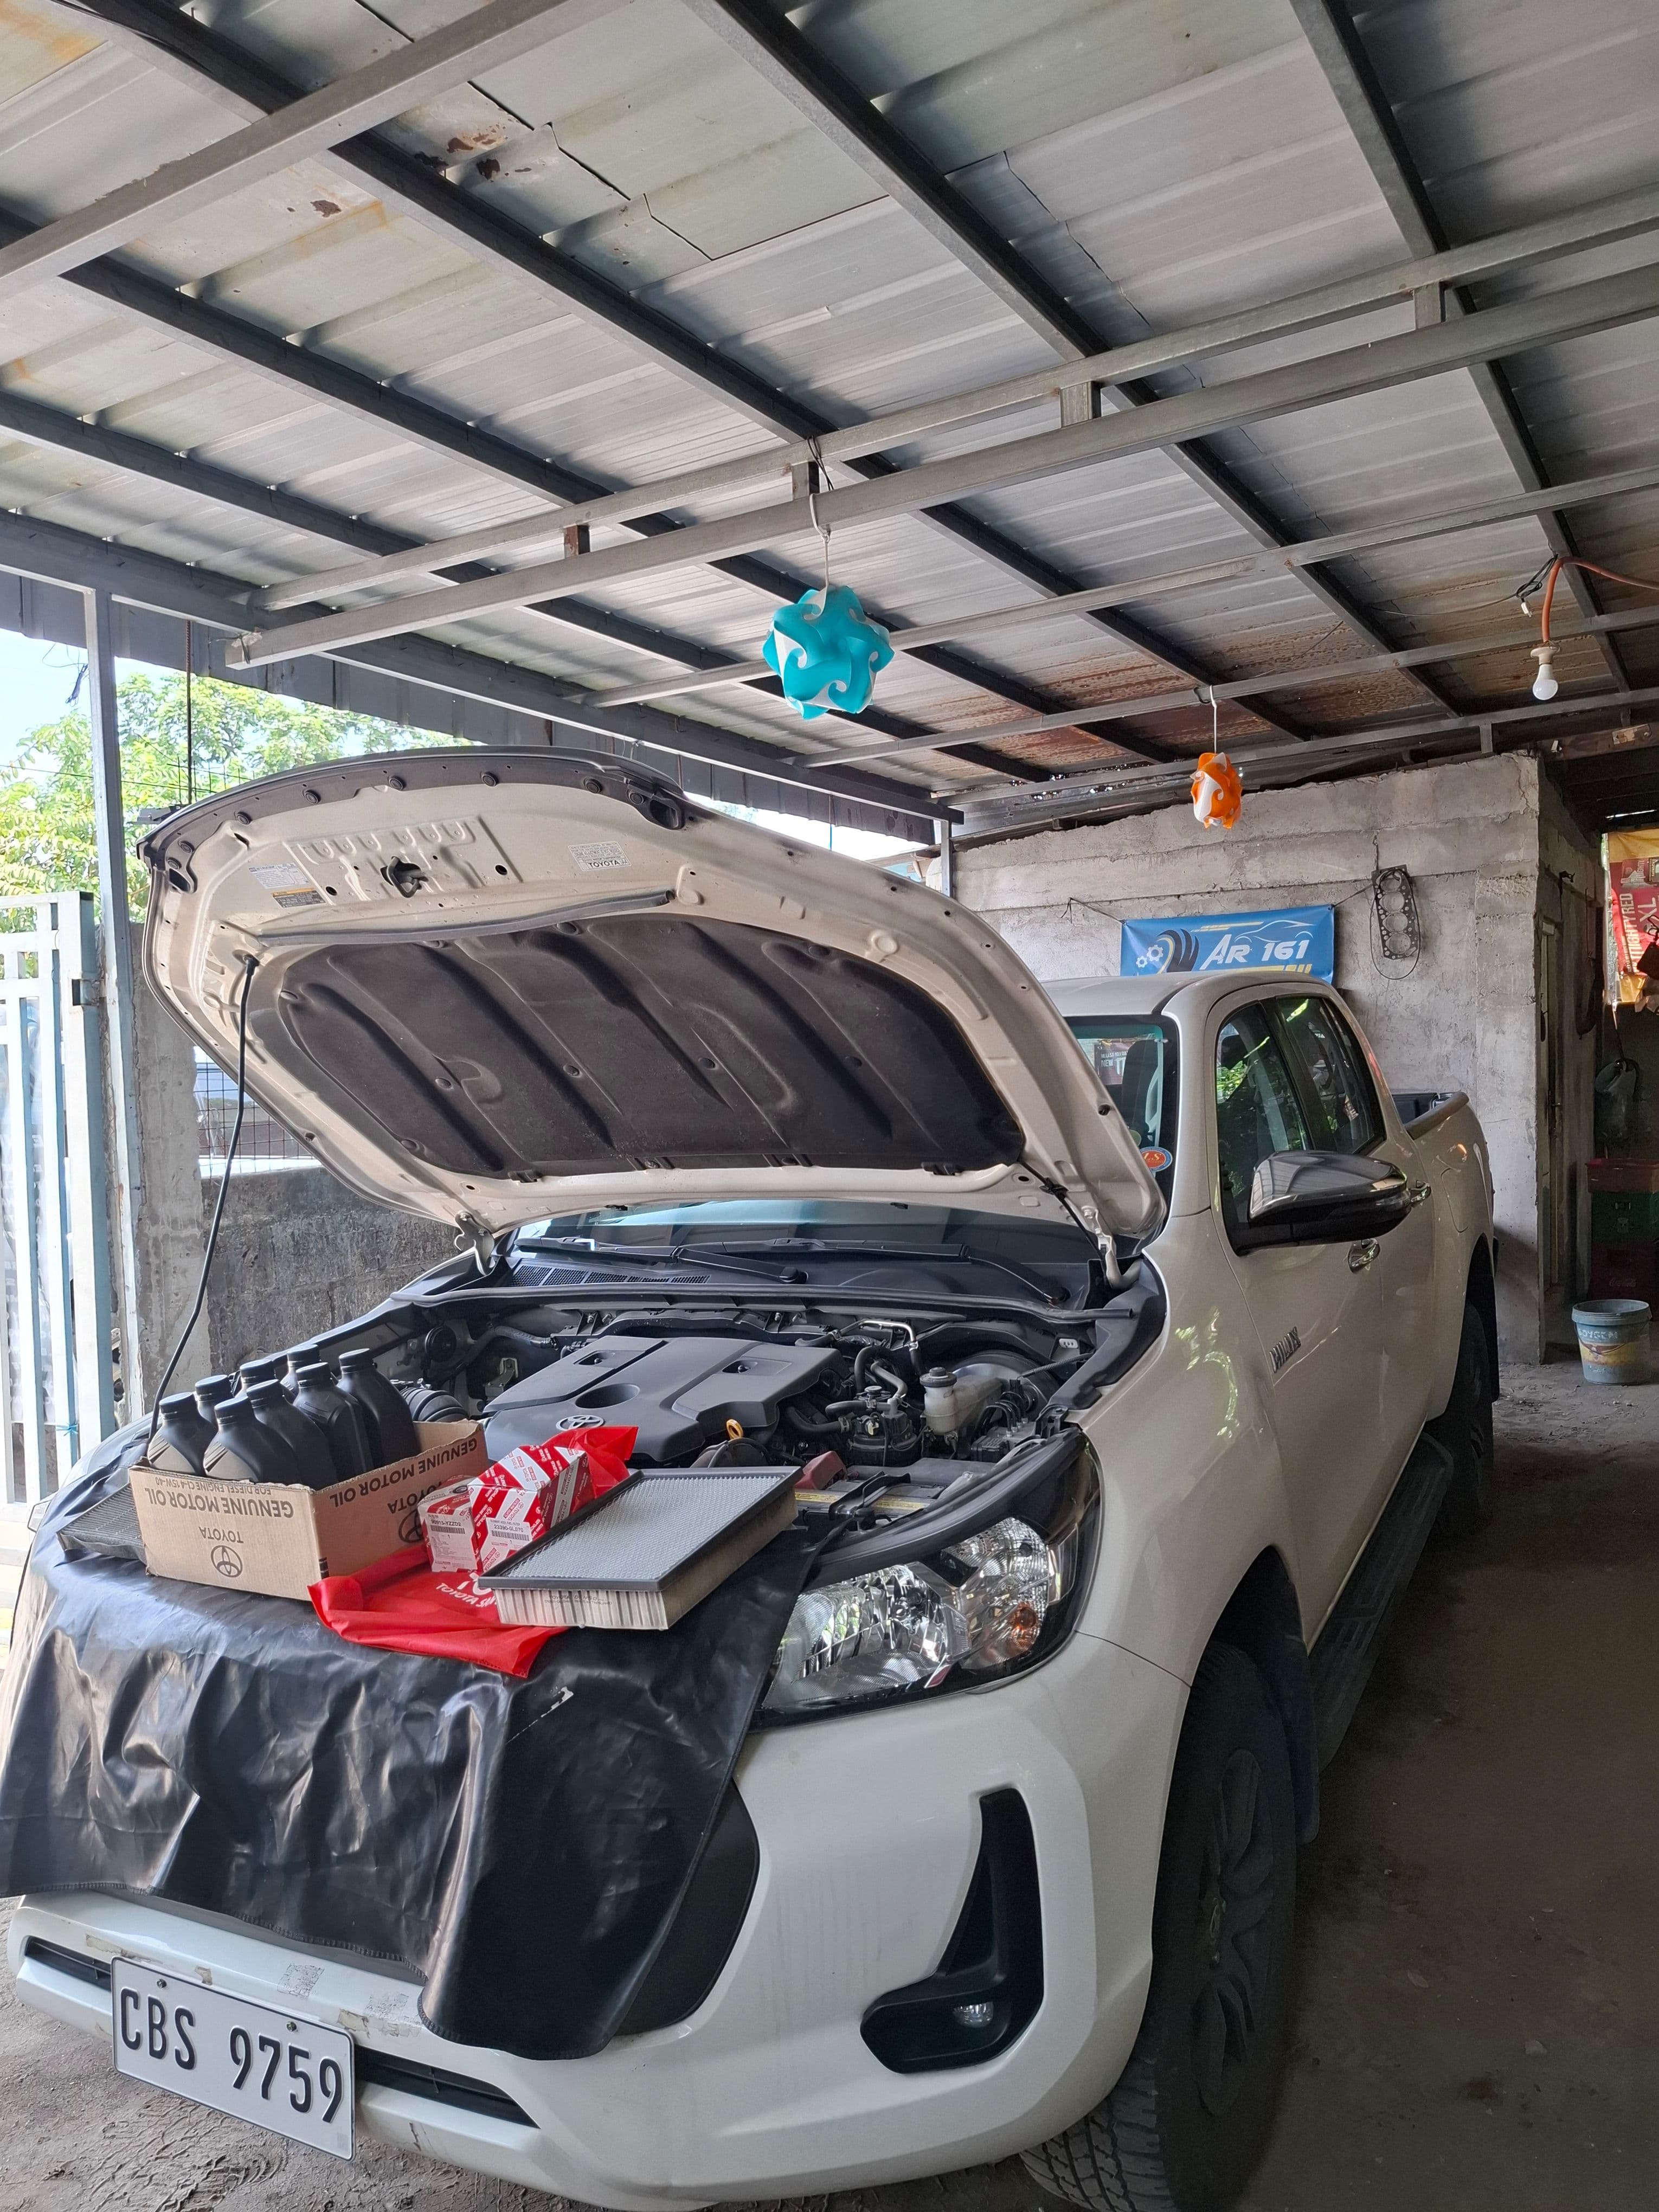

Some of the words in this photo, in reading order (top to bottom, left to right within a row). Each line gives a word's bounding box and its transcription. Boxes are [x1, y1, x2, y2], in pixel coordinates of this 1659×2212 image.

[588, 860, 621, 868] TOYOTA
[1619, 893, 1635, 914] RED
[1637, 897, 1657, 922] XL
[1200, 934, 1252, 970] AR
[1262, 940, 1310, 961] 161
[329, 1487, 356, 1508] OIL
[358, 1463, 415, 1492] MOTOR
[418, 1437, 478, 1474] GENUINE
[155, 1476, 180, 1488] 15W-40
[195, 1482, 224, 1493] ENGINE
[225, 1484, 252, 1495] DIESEL
[254, 1486, 271, 1496] FOR
[387, 1481, 442, 1514] OYOTA
[145, 1487, 166, 1507] OIL
[165, 1489, 218, 1513] MOTOR
[220, 1497, 294, 1519] GENUINE
[198, 1526, 243, 1544] TOYOTA
[436, 1583, 477, 1605] TOYOTA
[120, 1986, 197, 2070] CBS
[230, 2026, 344, 2124] 9759
